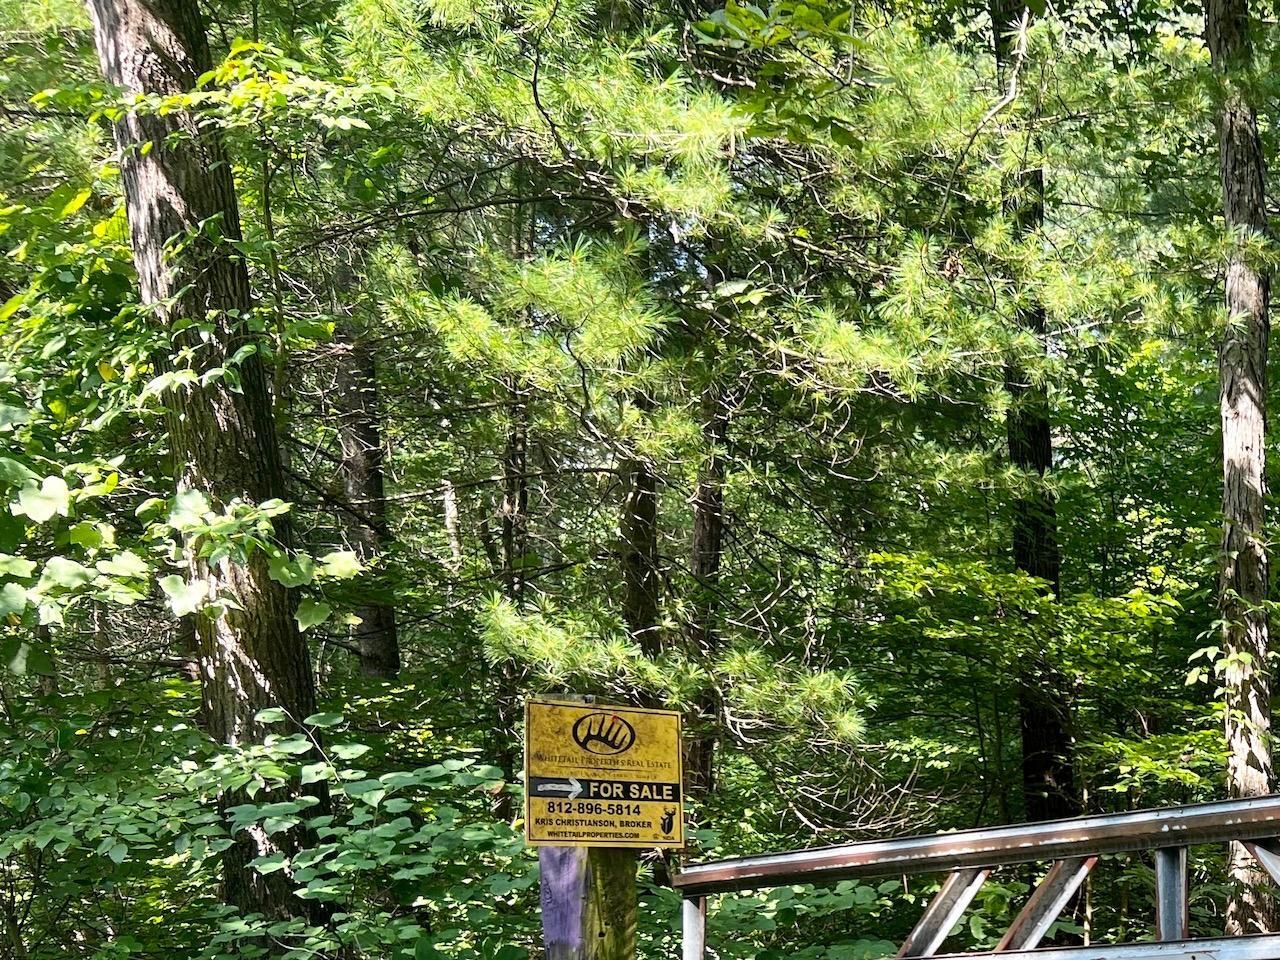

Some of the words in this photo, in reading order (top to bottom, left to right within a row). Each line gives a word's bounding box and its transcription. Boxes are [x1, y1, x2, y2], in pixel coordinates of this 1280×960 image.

[647, 760, 672, 769] ESTATE
[589, 782, 624, 798] FOR
[629, 785, 674, 800] SALE
[547, 802, 641, 816] 812-896-5814
[535, 817, 554, 826] KRIS
[555, 818, 618, 829] CHRISTIANSON,
[620, 820, 652, 829] BROKER
[547, 830, 640, 839] WHITETAILPROPERTIES.COM
